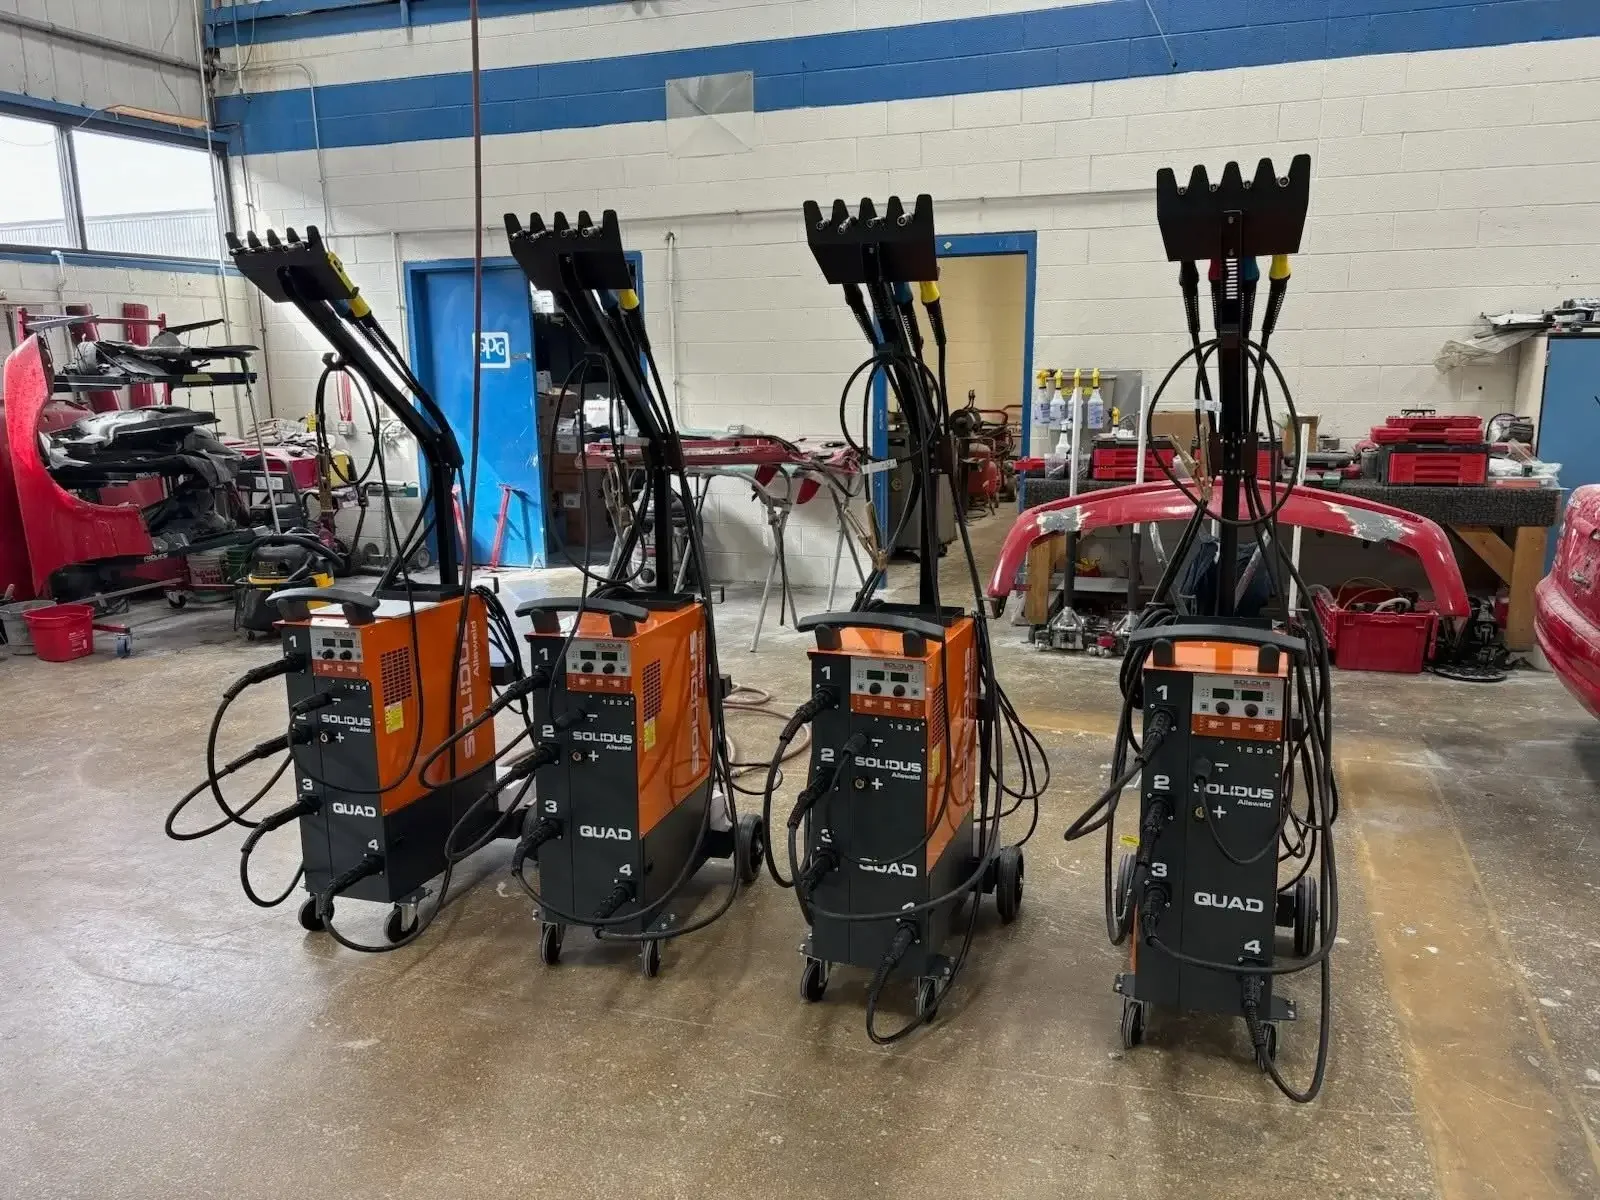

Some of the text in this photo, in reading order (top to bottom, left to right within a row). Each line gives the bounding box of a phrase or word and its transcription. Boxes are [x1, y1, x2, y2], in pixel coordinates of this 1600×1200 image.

[288, 635, 297, 648] 1
[539, 647, 549, 661] 1
[820, 665, 831, 680] 1
[1156, 685, 1168, 700] 1
[321, 713, 371, 727] SOLIDUS
[542, 724, 555, 738] 2
[572, 731, 633, 744] SOLIDUS
[820, 747, 835, 763] 2
[854, 756, 922, 773] SOLIDUS
[302, 778, 313, 791] 3
[1153, 774, 1170, 791] 2
[332, 802, 377, 818] QUAD
[544, 800, 558, 813] 3
[579, 825, 632, 841] QUAD
[367, 839, 379, 851] 4
[619, 863, 632, 877] 4
[859, 857, 917, 877] QUAD
[1151, 862, 1168, 878] 3
[1193, 891, 1264, 913] QUAD
[1244, 939, 1261, 955] 4
